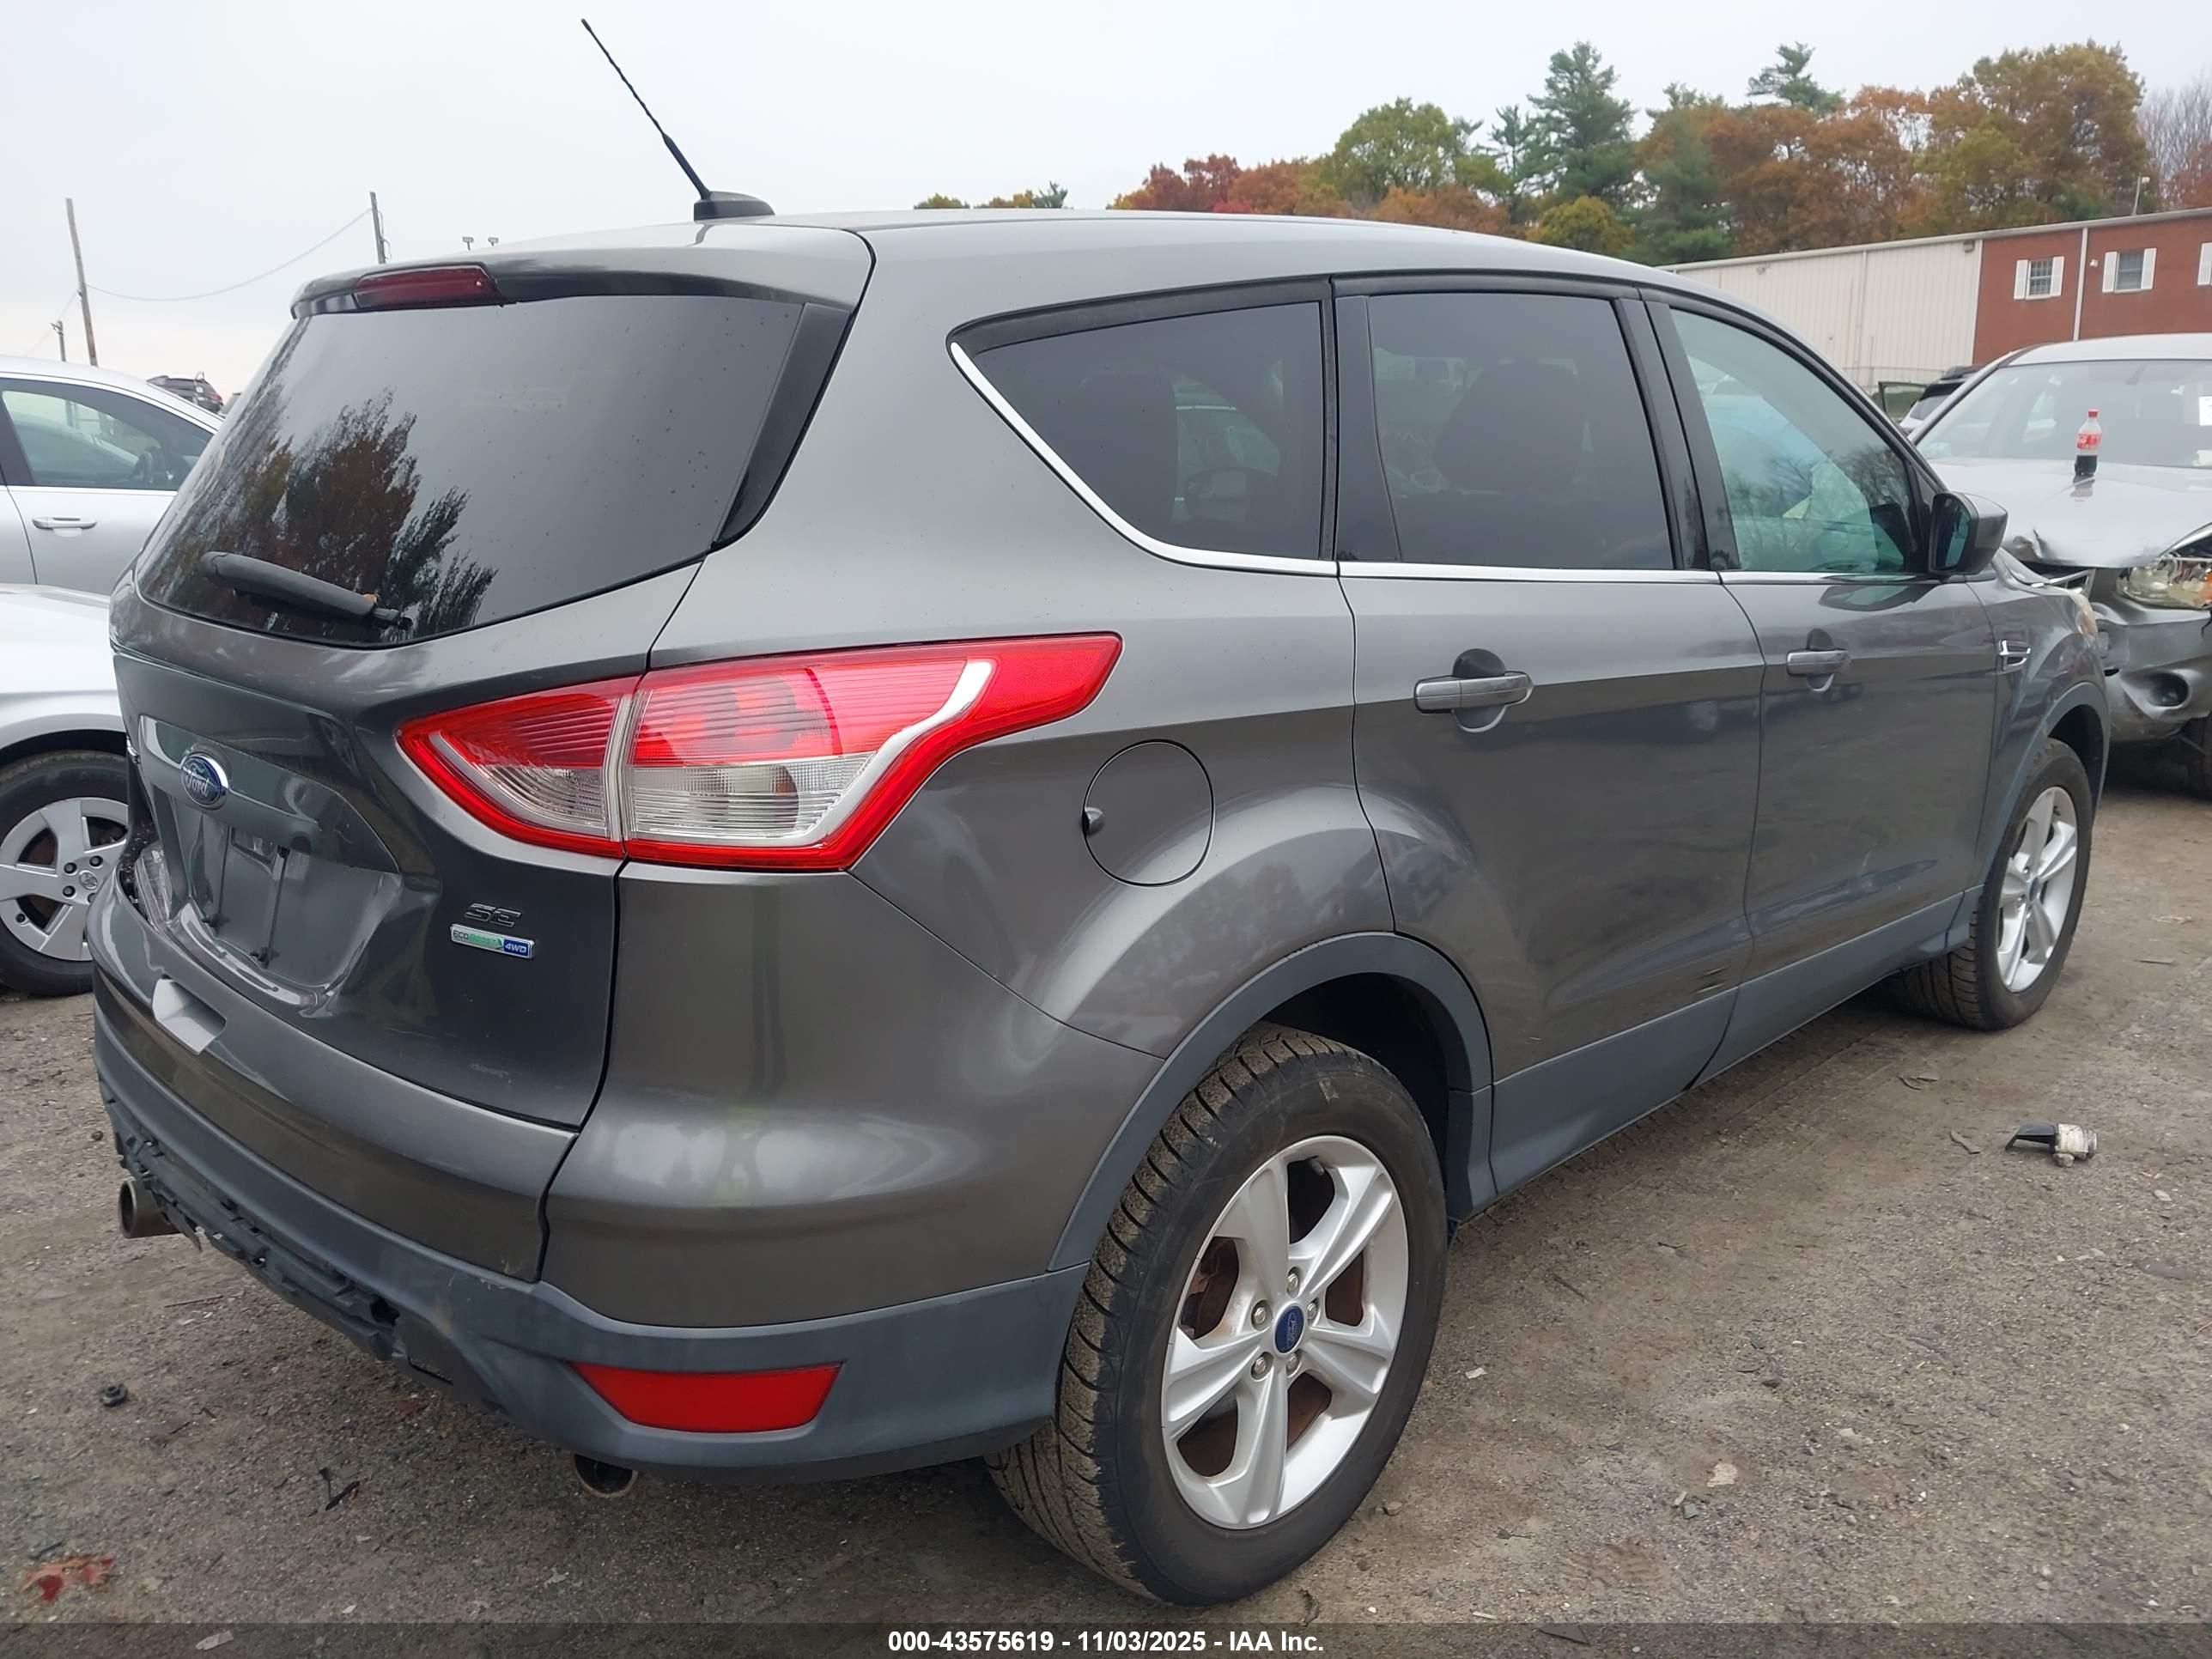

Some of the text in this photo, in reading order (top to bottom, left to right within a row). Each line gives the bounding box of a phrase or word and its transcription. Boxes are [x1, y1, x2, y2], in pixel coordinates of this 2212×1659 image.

[185, 763, 210, 797] Ford
[465, 903, 521, 927] SE
[505, 943, 527, 953] 4WD
